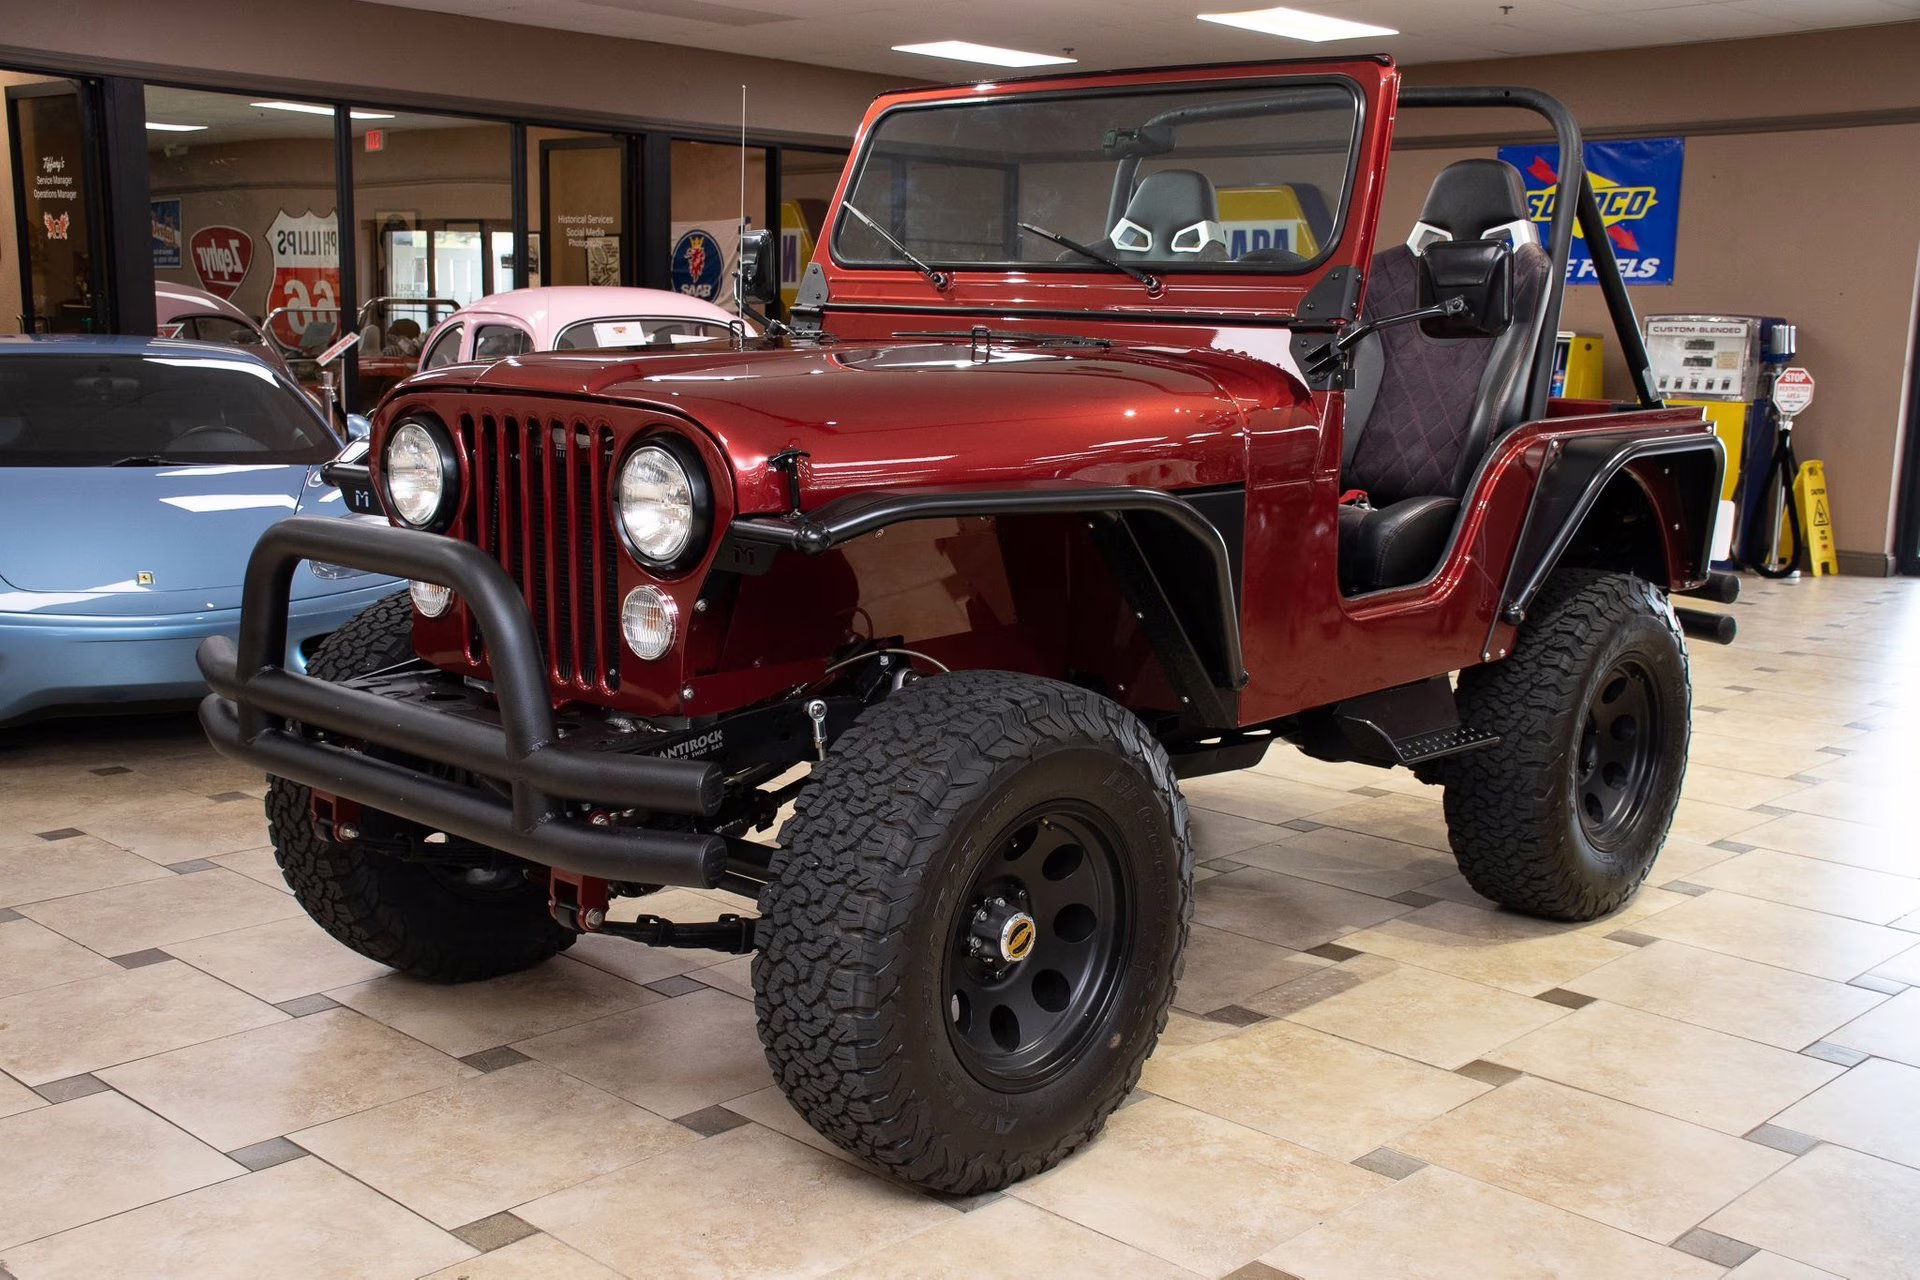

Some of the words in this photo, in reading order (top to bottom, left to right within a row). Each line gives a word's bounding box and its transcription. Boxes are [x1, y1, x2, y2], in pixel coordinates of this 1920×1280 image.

[36, 176, 53, 185] Service
[53, 176, 73, 187] Manager
[33, 189, 57, 200] Operations
[57, 190, 77, 201] Manager
[558, 216, 587, 224] Historical
[587, 215, 614, 224] Services
[566, 228, 585, 237] Social
[585, 228, 605, 237] Media
[1577, 258, 1661, 278] FELS
[681, 284, 712, 297] SAAB
[1784, 372, 1806, 383] STOP
[660, 729, 723, 758] ANTIROCK
[691, 747, 708, 757] SWAY
[711, 742, 723, 751] BAR
